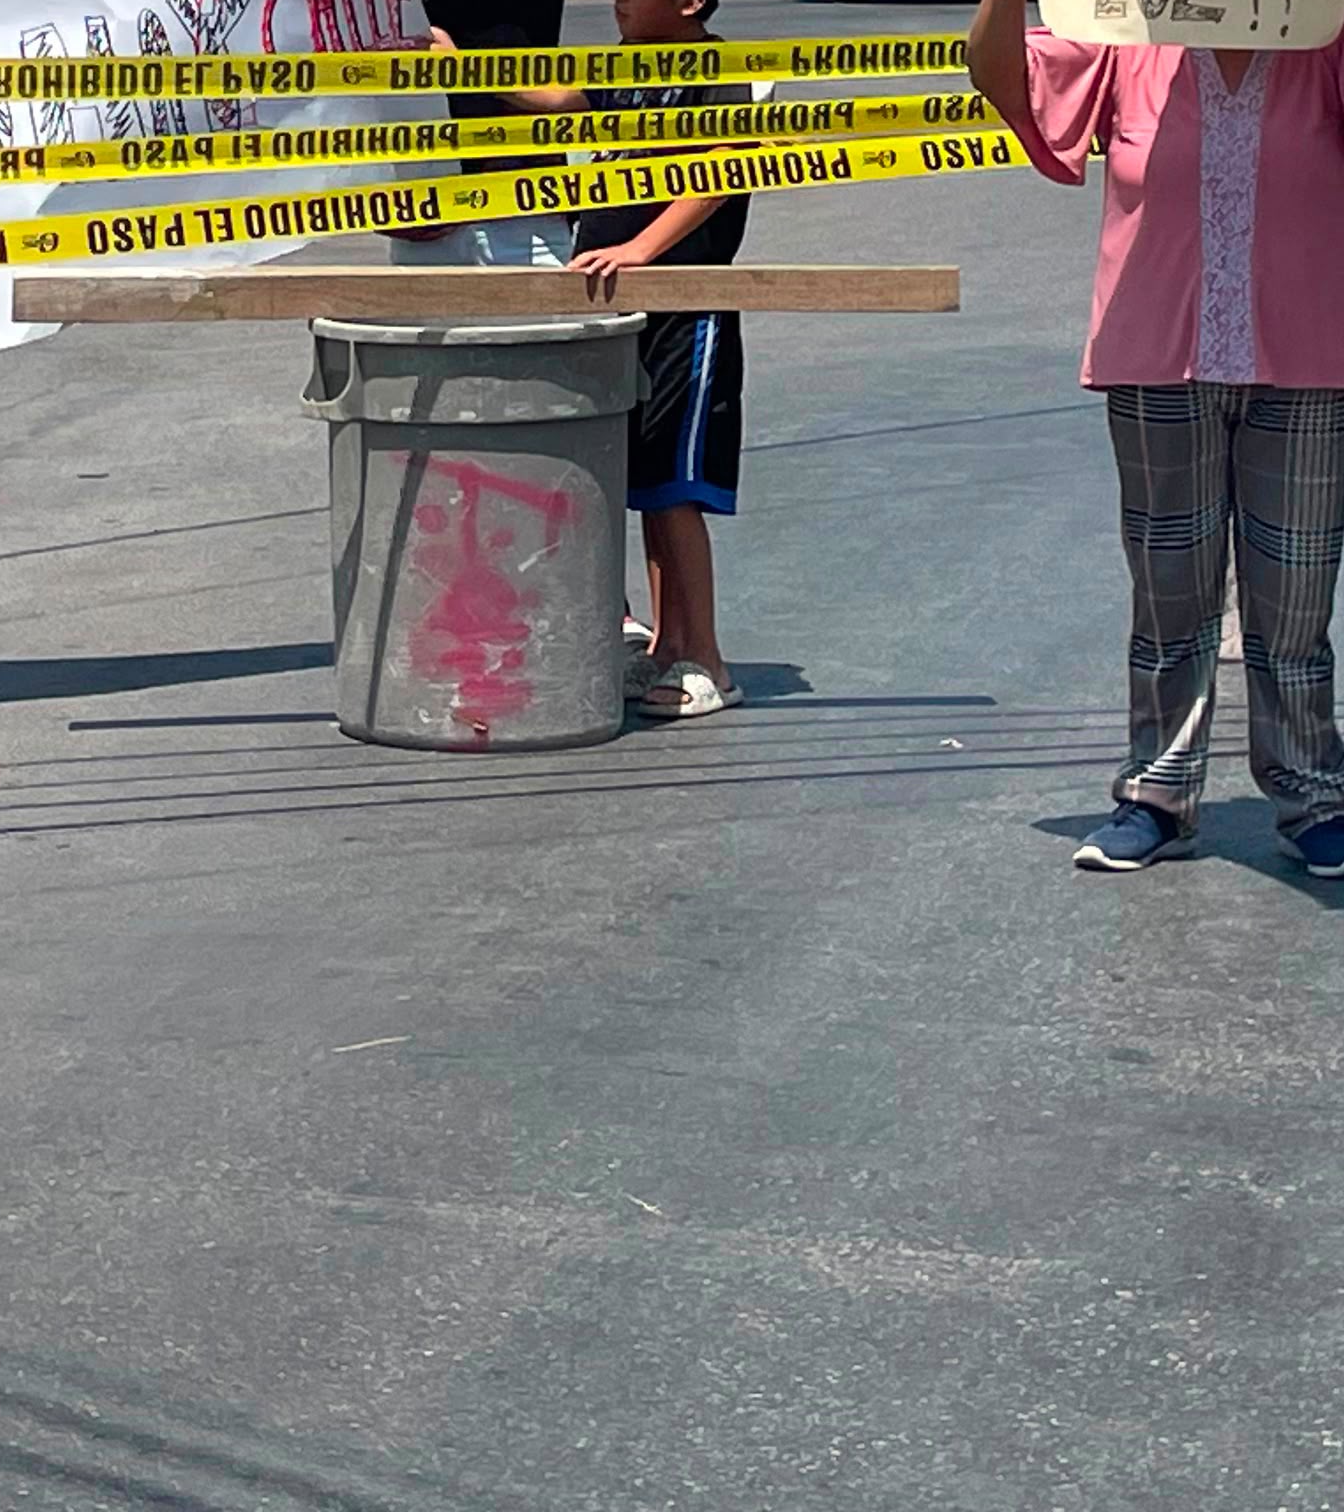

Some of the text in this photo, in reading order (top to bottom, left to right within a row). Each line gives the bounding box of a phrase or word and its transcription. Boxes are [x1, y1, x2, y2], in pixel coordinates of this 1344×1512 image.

[514, 147, 853, 212] PROHIBIDO EL PASO
[920, 135, 1012, 171] PASO
[86, 186, 442, 254] PROHIBIDO EL PASO
